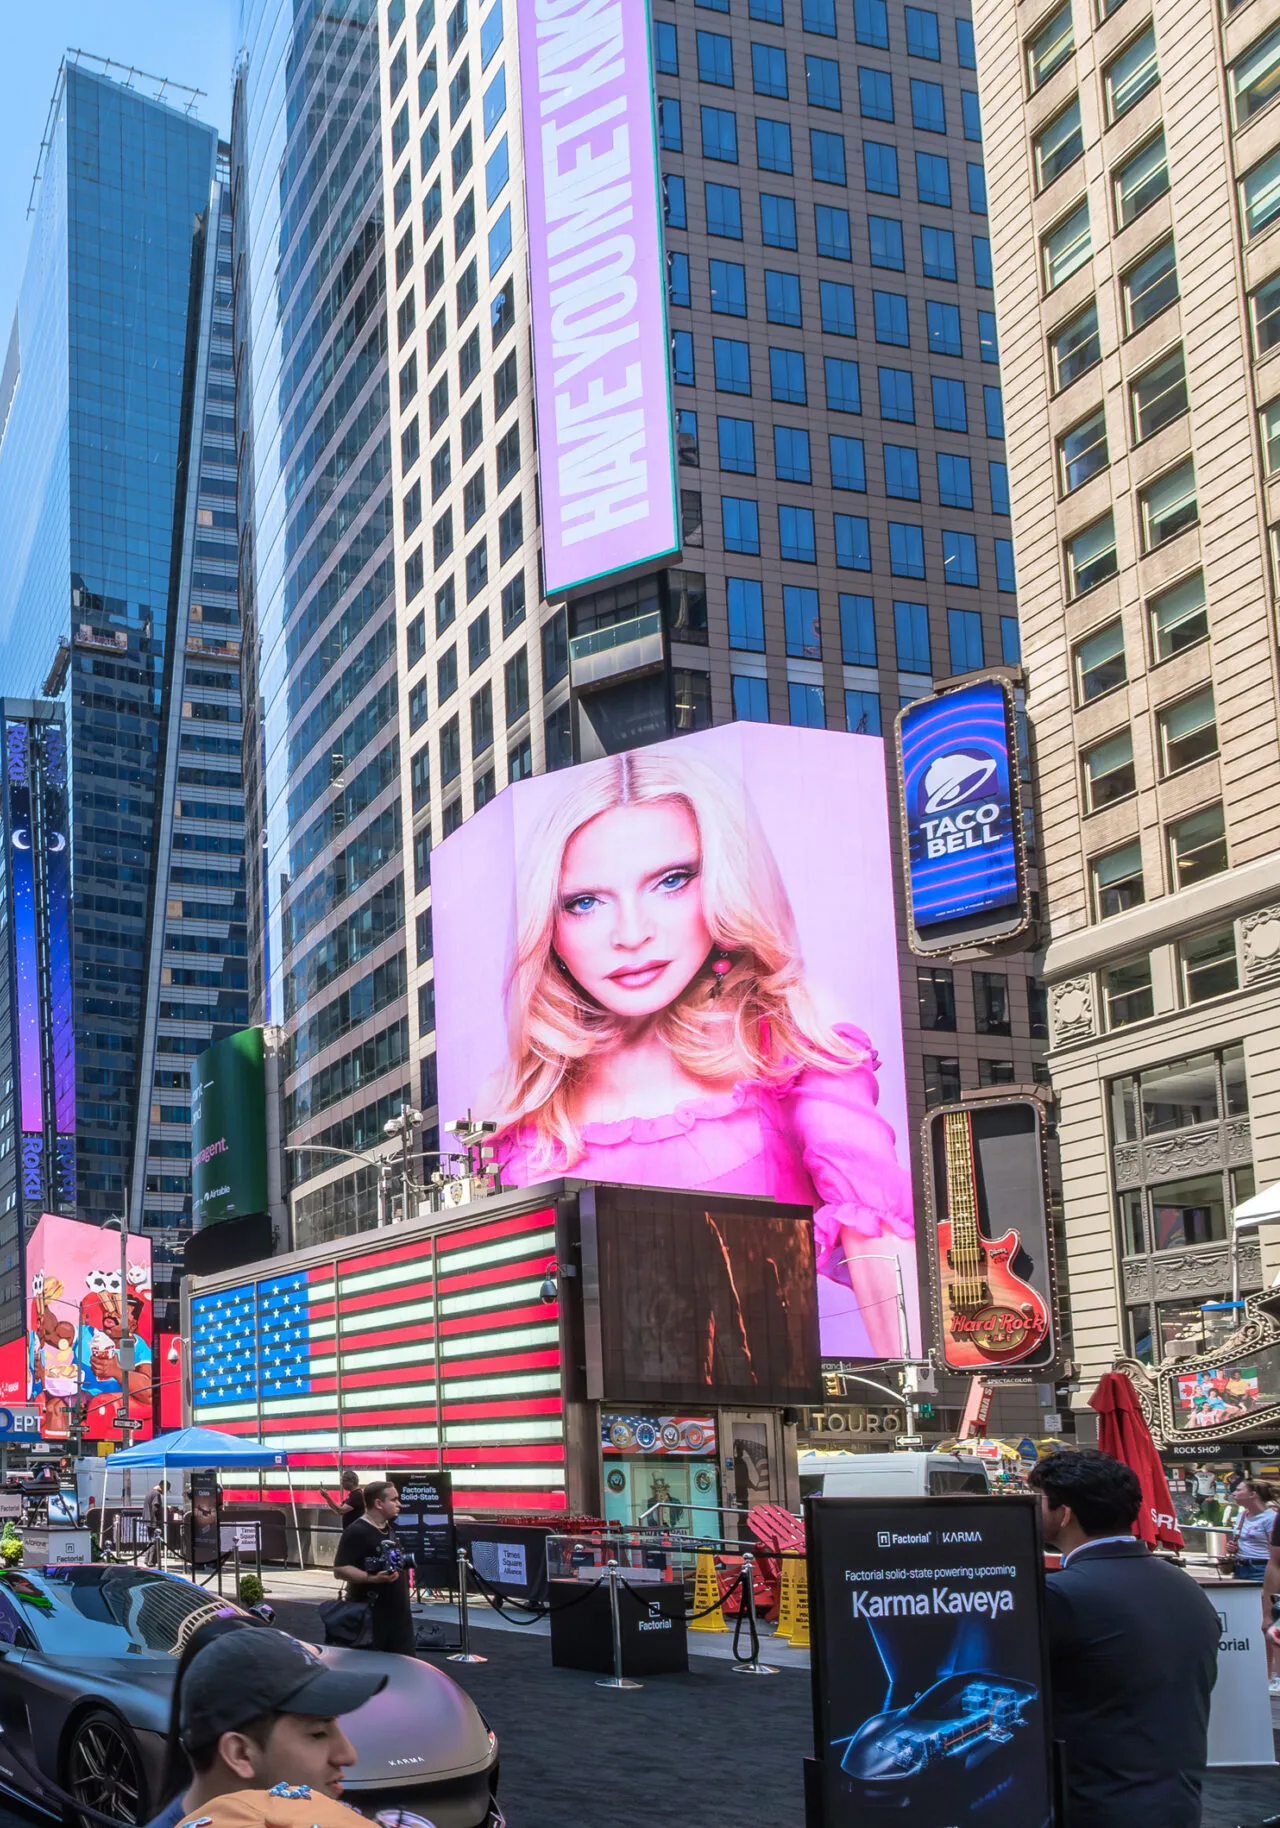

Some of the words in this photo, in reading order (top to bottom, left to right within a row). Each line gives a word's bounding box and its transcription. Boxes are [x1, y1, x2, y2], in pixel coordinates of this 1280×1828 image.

[540, 95, 634, 261] MET
[547, 233, 641, 388] YOU
[555, 360, 650, 547] HAVE
[8, 723, 28, 781] ROKU
[920, 803, 1000, 841] TACO
[927, 823, 1003, 860] BELL
[23, 1137, 43, 1200] ROKU
[950, 1315, 998, 1333] Hard
[999, 1312, 1045, 1334] Rock
[987, 1377, 1033, 1385] SPECTACOLOR
[812, 1413, 900, 1433] TOURO
[1173, 1447, 1196, 1455] ROCK
[1197, 1446, 1221, 1454] SHOP
[400, 1493, 439, 1501] Solid-State
[402, 1486, 437, 1494] Factorial's
[942, 1531, 983, 1543] KARMA
[503, 1550, 521, 1558] Times
[845, 1570, 885, 1581] Factorial
[885, 1568, 933, 1580] solid-state
[934, 1566, 974, 1580] powering
[974, 1564, 1016, 1578] upcoming
[852, 1591, 930, 1618] Karma
[932, 1587, 1014, 1619] Kaveya
[638, 1619, 672, 1631] Factorial
[388, 1756, 425, 1768] KARMA
